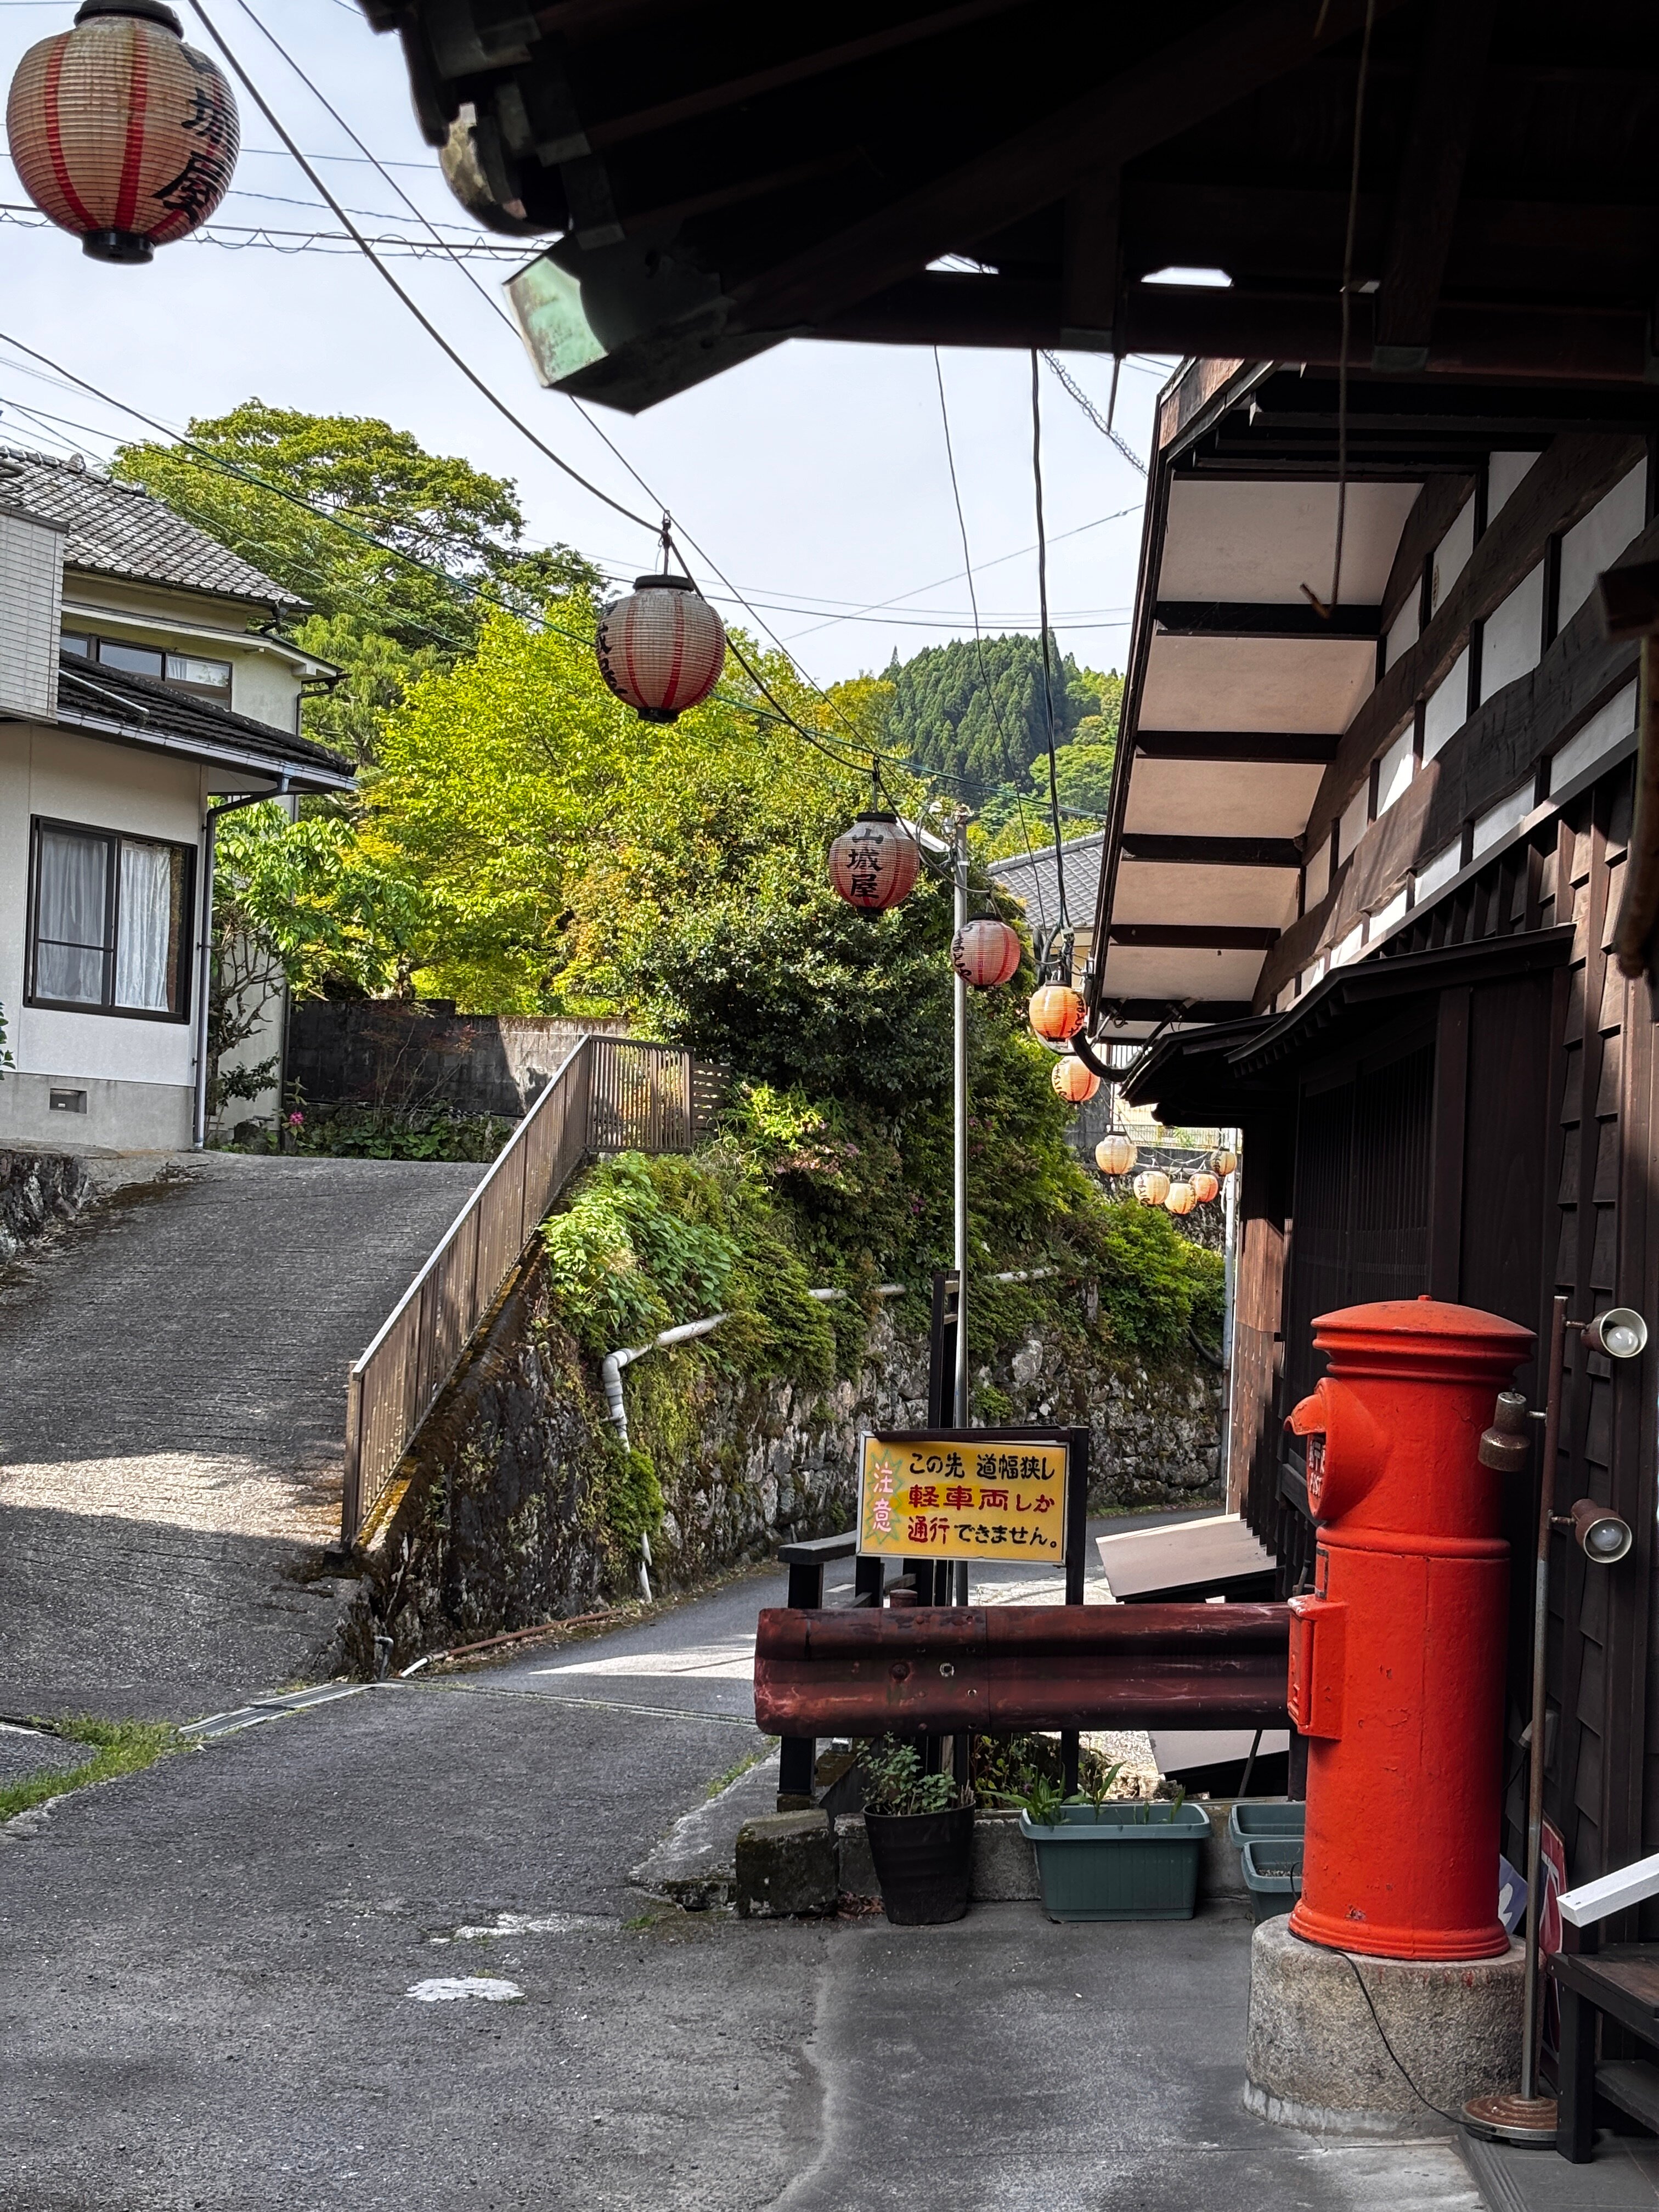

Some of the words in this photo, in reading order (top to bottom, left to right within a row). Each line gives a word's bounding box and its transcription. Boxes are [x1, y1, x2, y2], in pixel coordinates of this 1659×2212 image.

[846, 827, 884, 899] 山城屋
[909, 1451, 966, 1479] この先
[976, 1453, 1055, 1480] 道幅狭し
[873, 1460, 894, 1533] 注意
[908, 1483, 1056, 1513] 軽車両しか
[907, 1515, 1057, 1549] 通行できません。
